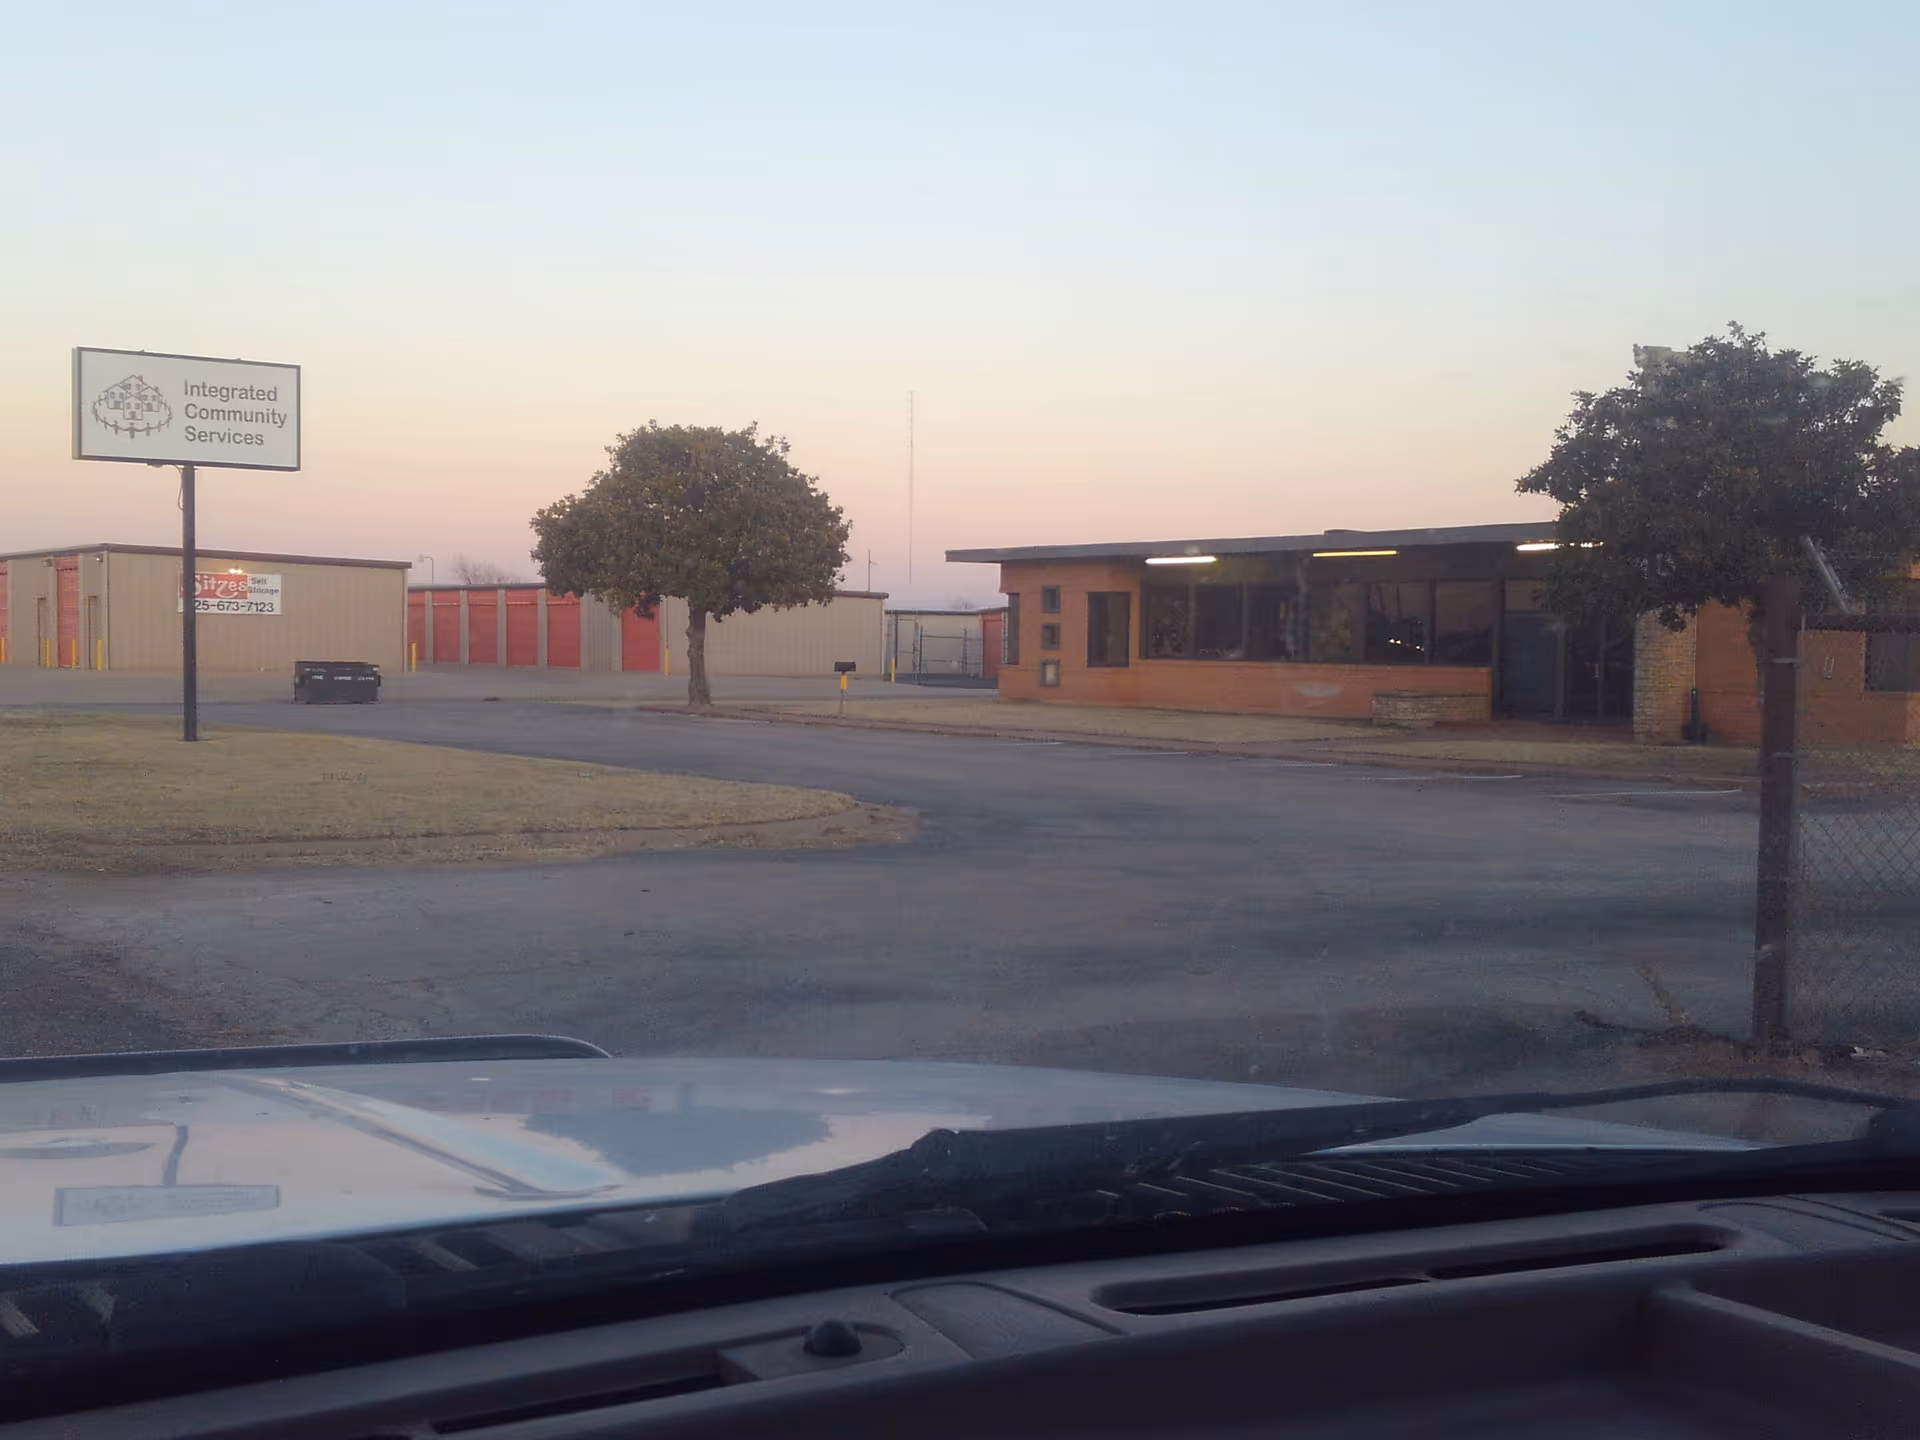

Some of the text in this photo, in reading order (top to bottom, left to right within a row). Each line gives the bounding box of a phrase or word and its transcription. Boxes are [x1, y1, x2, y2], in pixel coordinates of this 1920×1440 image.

[184, 379, 277, 402] Integrated
[184, 403, 287, 428] Community
[184, 426, 264, 446] Services
[194, 600, 274, 612] 25-673-7123
